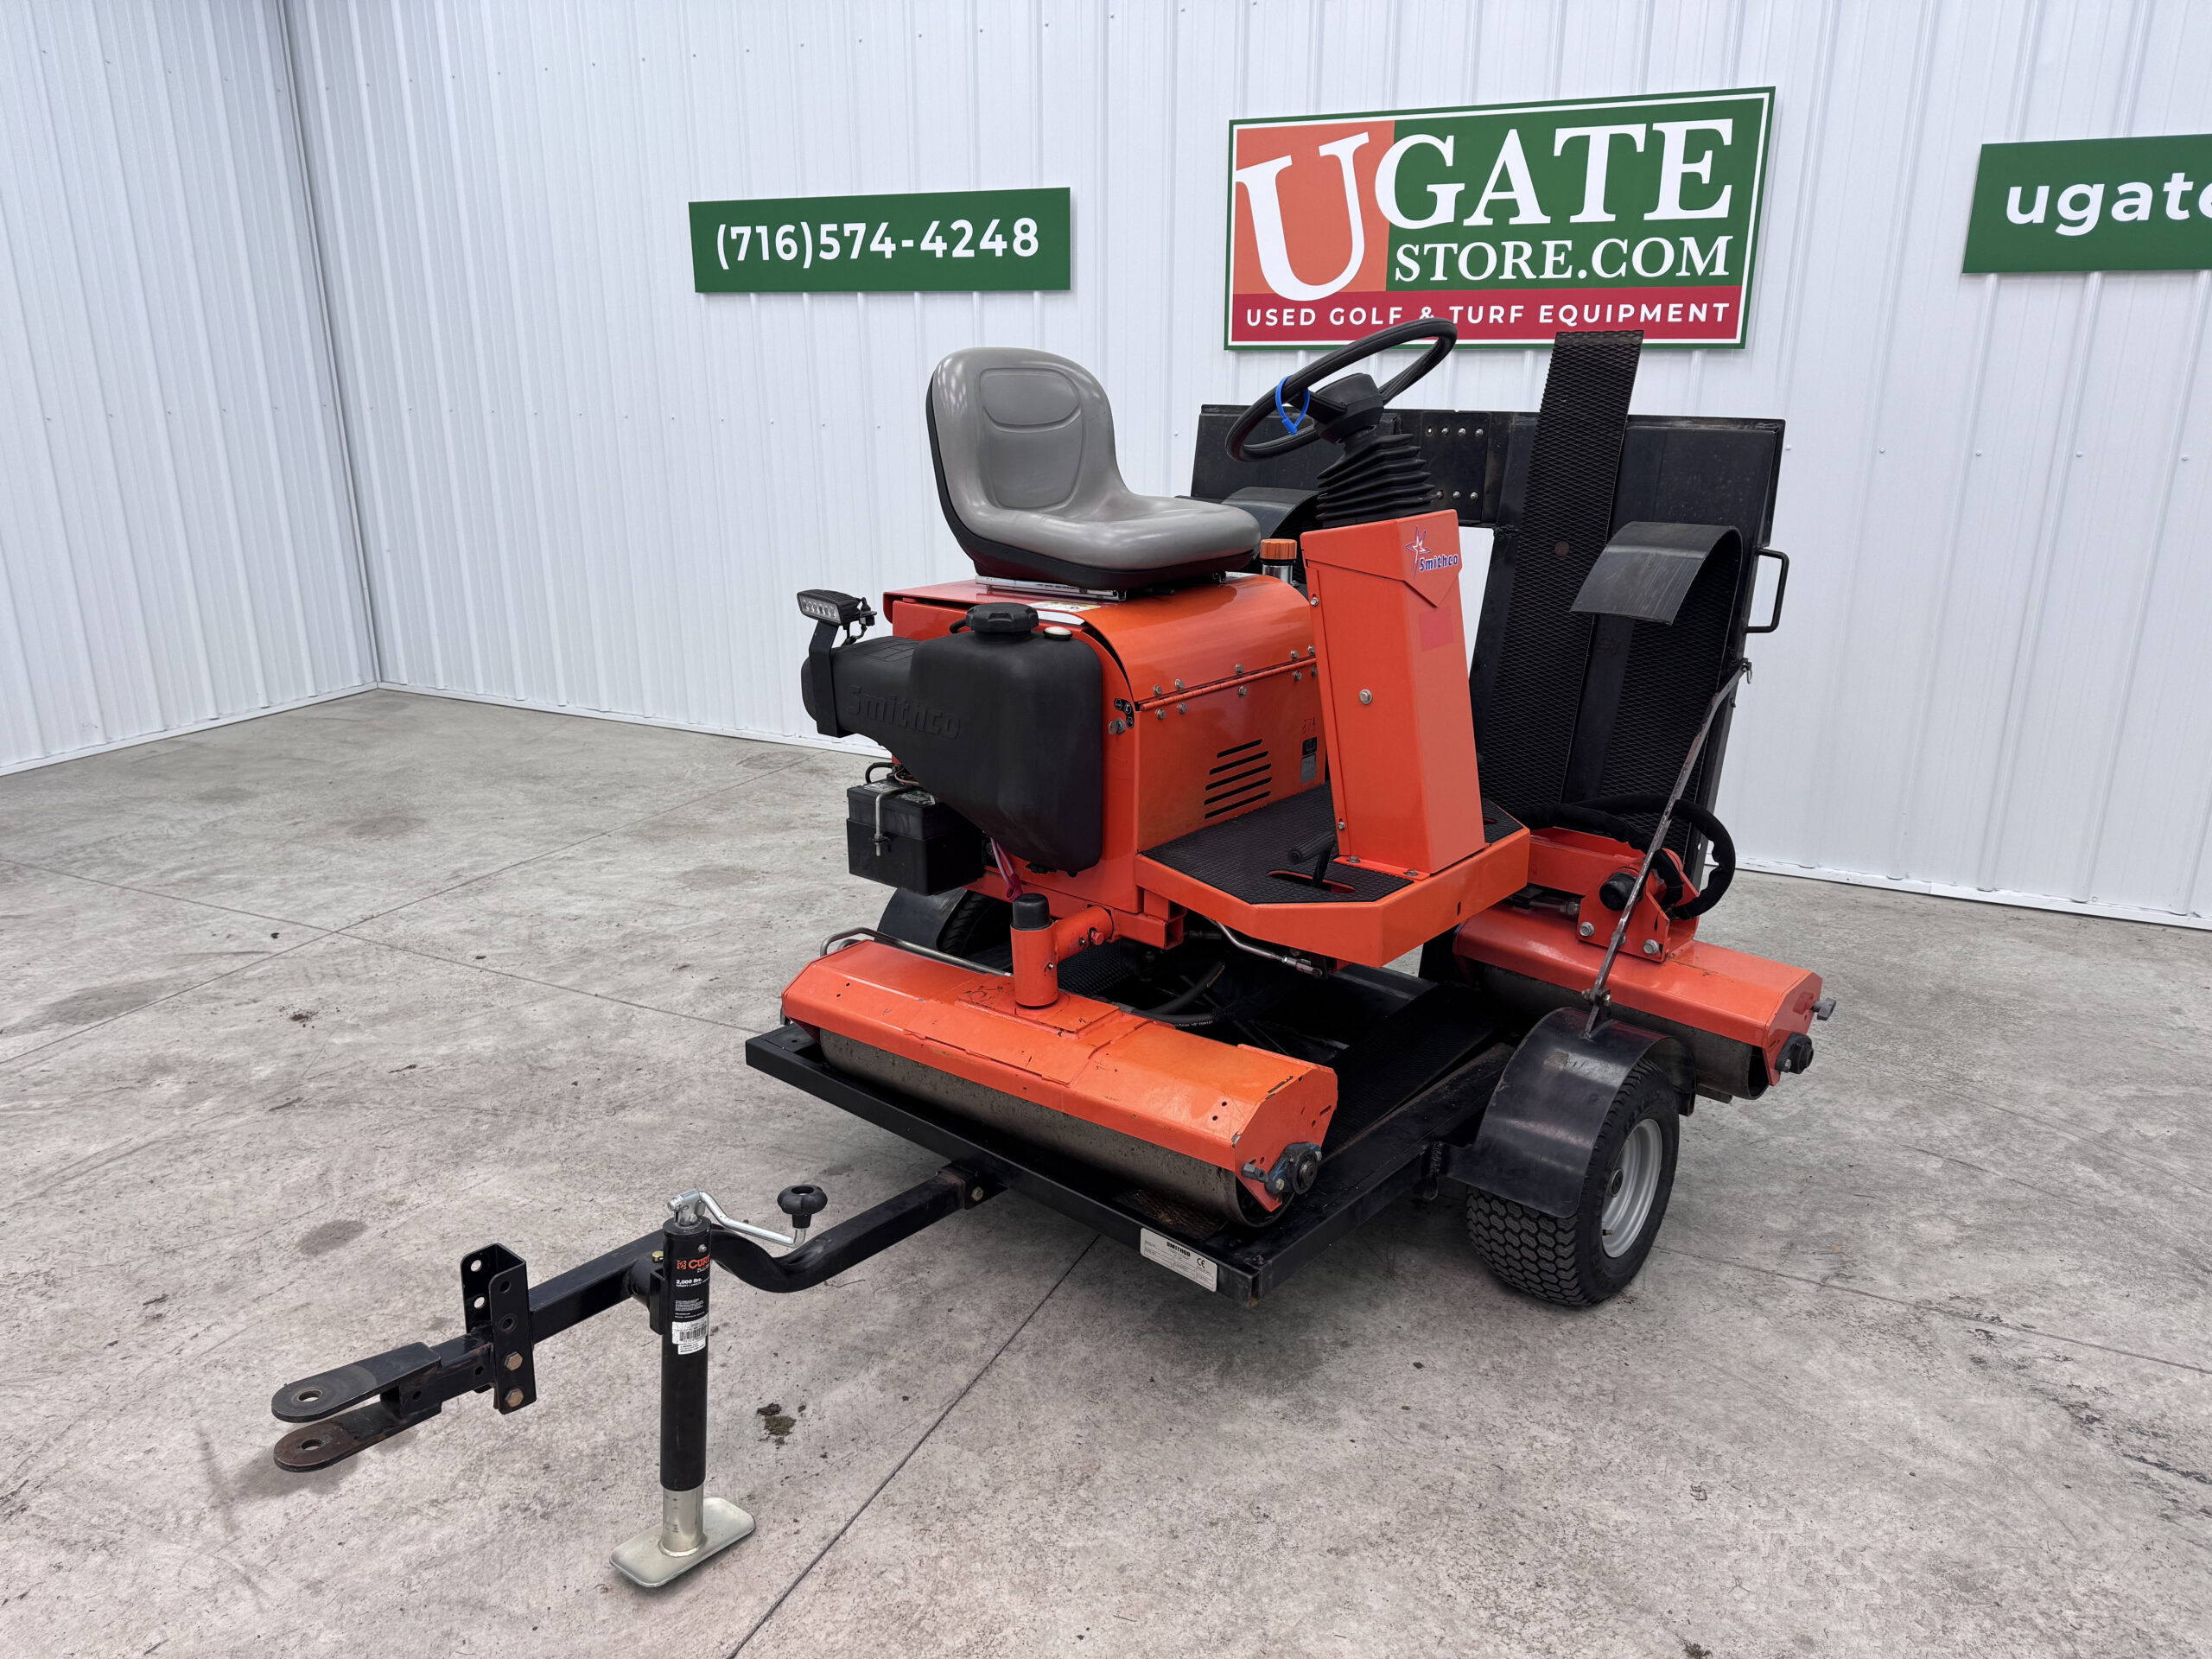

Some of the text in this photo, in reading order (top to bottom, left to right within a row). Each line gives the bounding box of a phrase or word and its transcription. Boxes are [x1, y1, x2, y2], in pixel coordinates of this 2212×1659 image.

[1236, 118, 1733, 302] UGATE
[716, 217, 1039, 270] (716)574-4248
[1395, 235, 1734, 283] STORE.COM
[1246, 302, 1730, 327] USED GOLF & TURF EQUIPMENT
[1419, 554, 1459, 573] Smithco
[846, 684, 961, 741] Smithco
